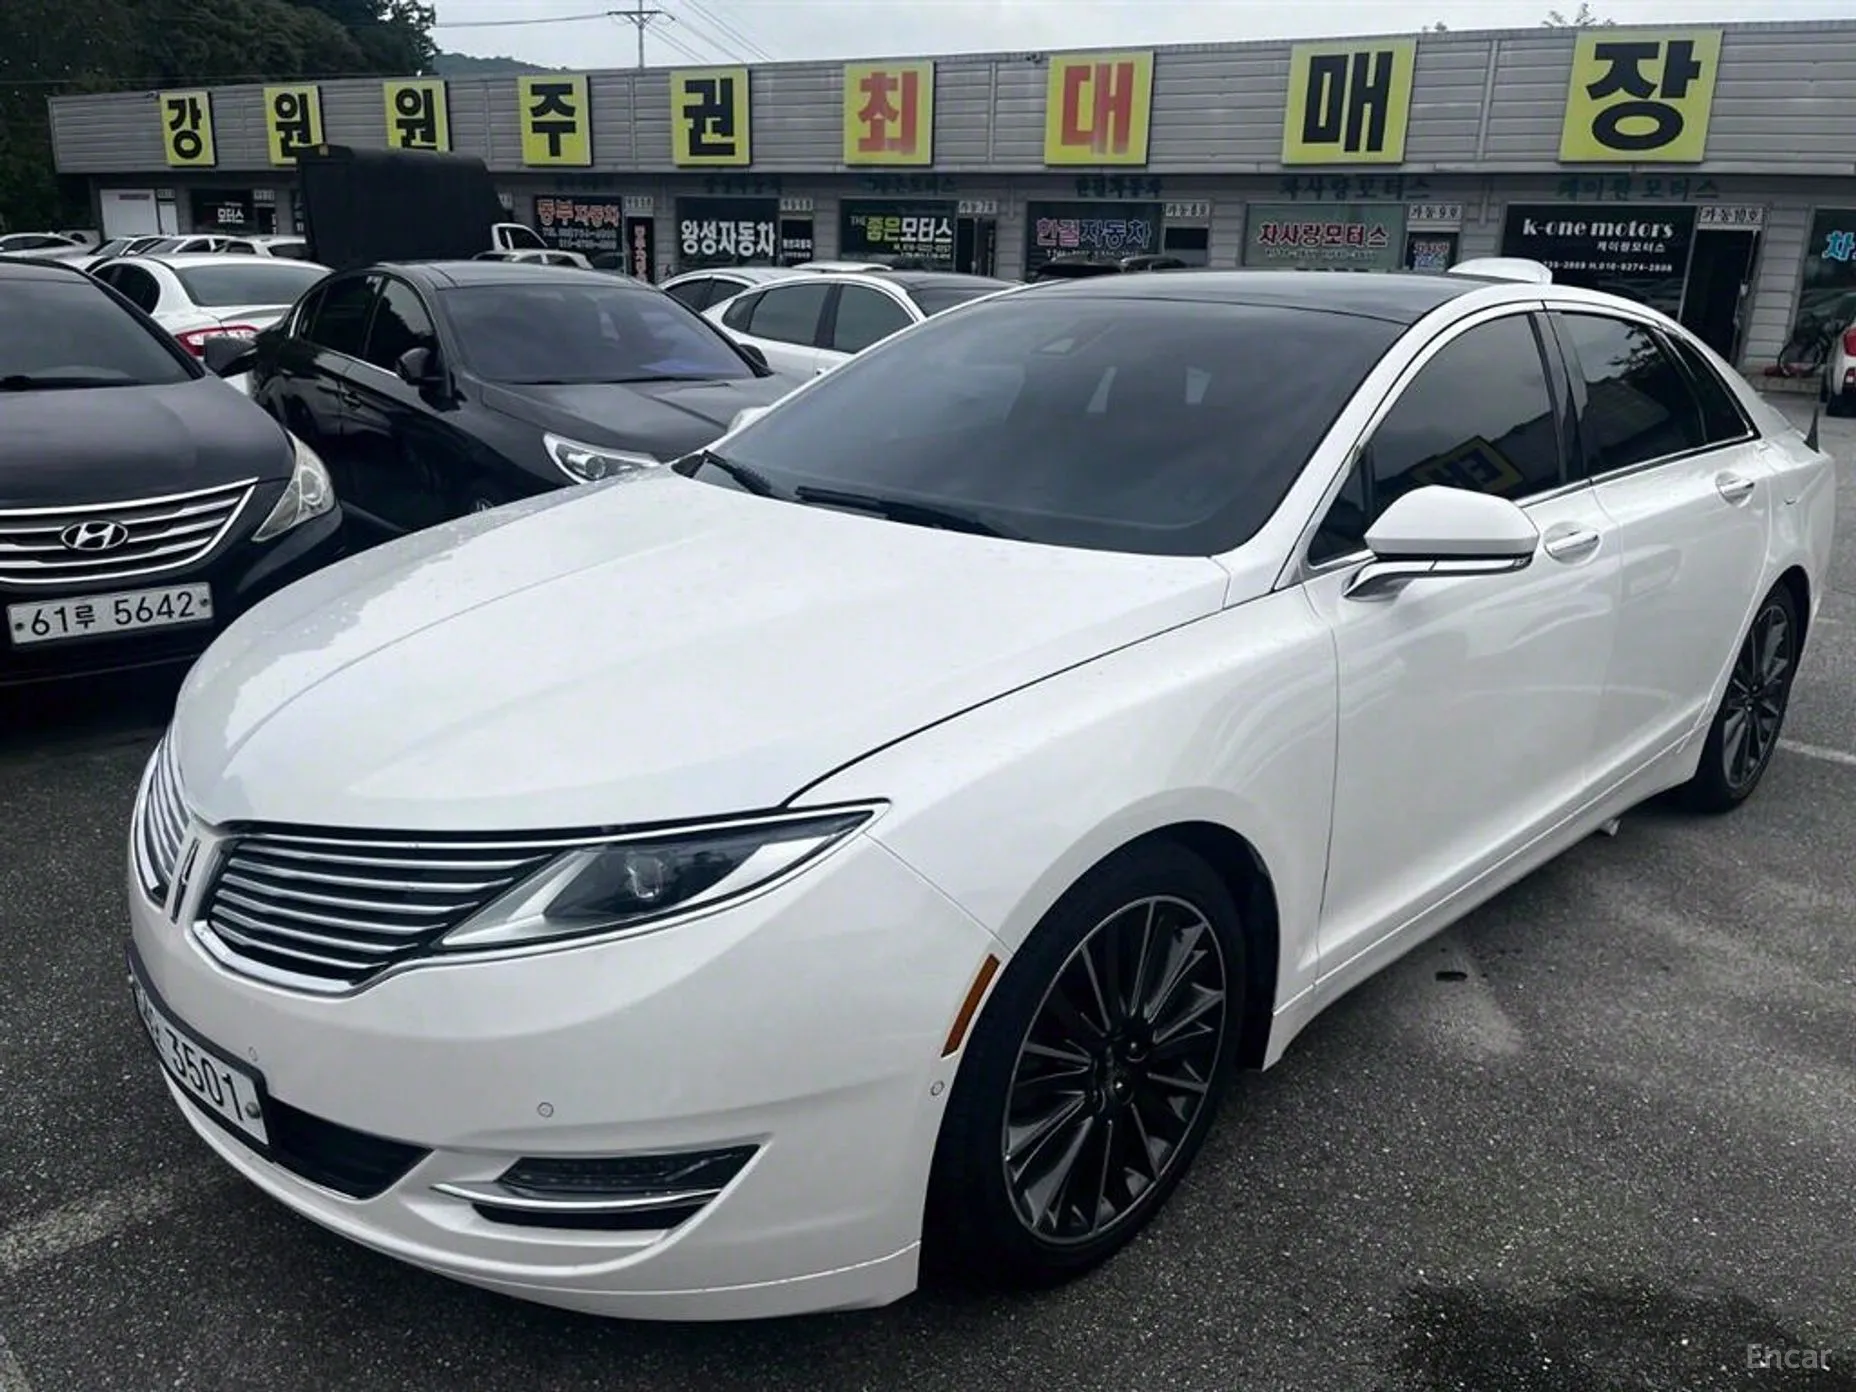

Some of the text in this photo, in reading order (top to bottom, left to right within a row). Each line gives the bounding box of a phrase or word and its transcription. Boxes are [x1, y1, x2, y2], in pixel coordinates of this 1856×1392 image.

[168, 40, 1701, 159] 강 원 원 주 권 최 대 매 장
[681, 220, 775, 257] 왕성자동차
[867, 216, 952, 242] 좋은모터스
[1522, 218, 1674, 238] k-one motors
[1822, 231, 1856, 261] 차
[31, 591, 195, 636] 61루 5642
[166, 1028, 243, 1121] 3501
